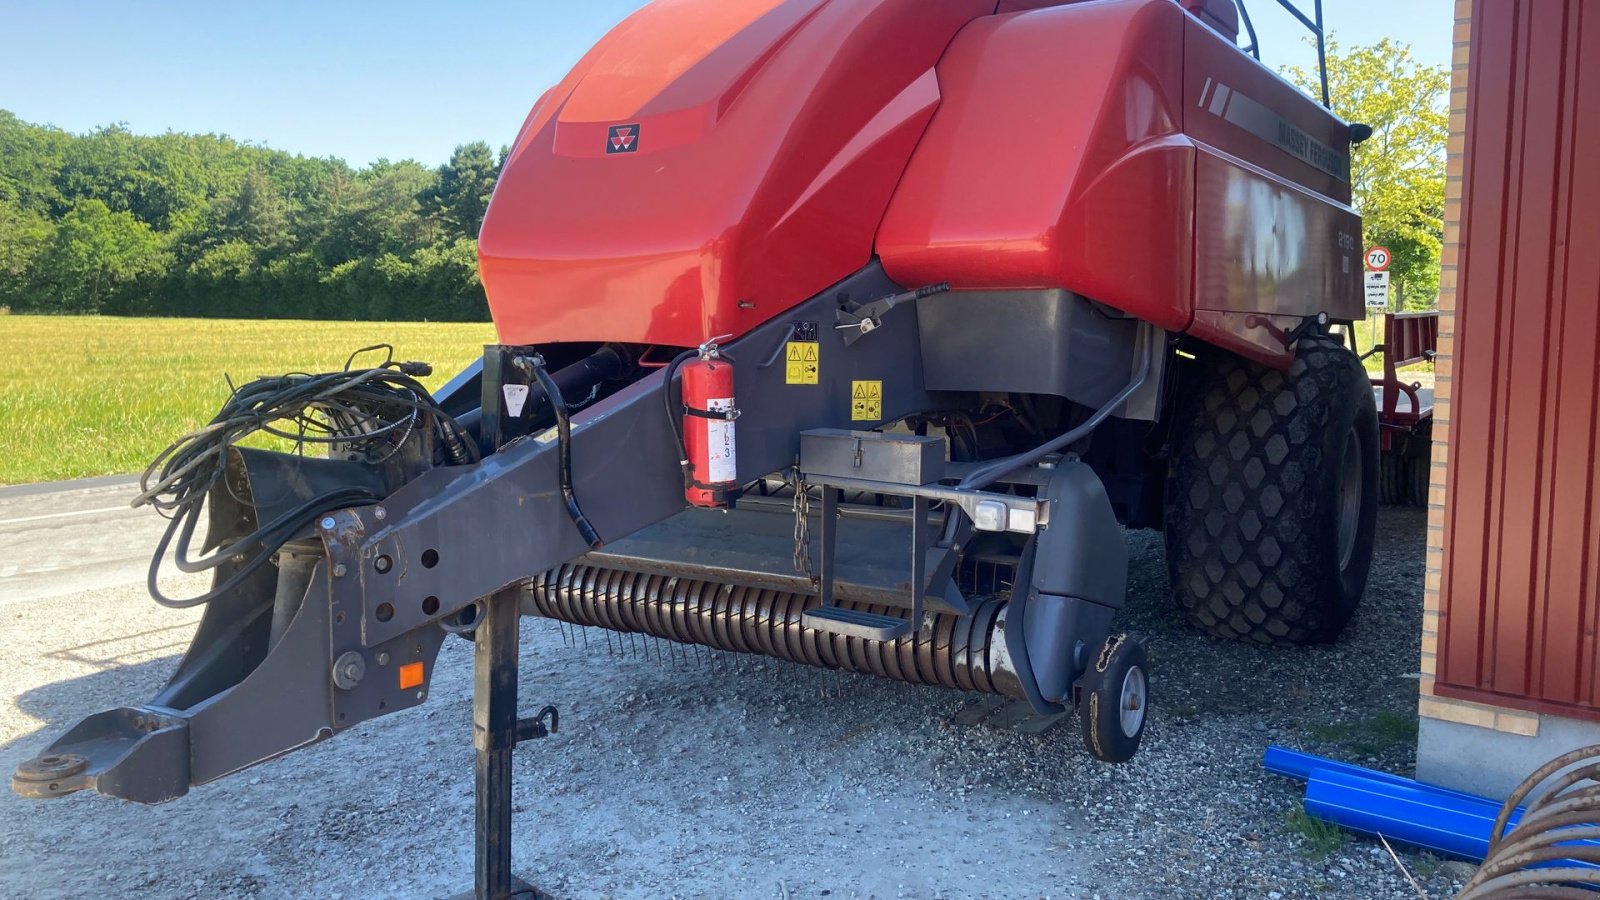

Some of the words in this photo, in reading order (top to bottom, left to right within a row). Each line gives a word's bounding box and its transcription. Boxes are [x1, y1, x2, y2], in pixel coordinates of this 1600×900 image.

[1278, 119, 1308, 159] MASSEY
[1370, 253, 1386, 264] 70
[725, 447, 730, 458] 3
